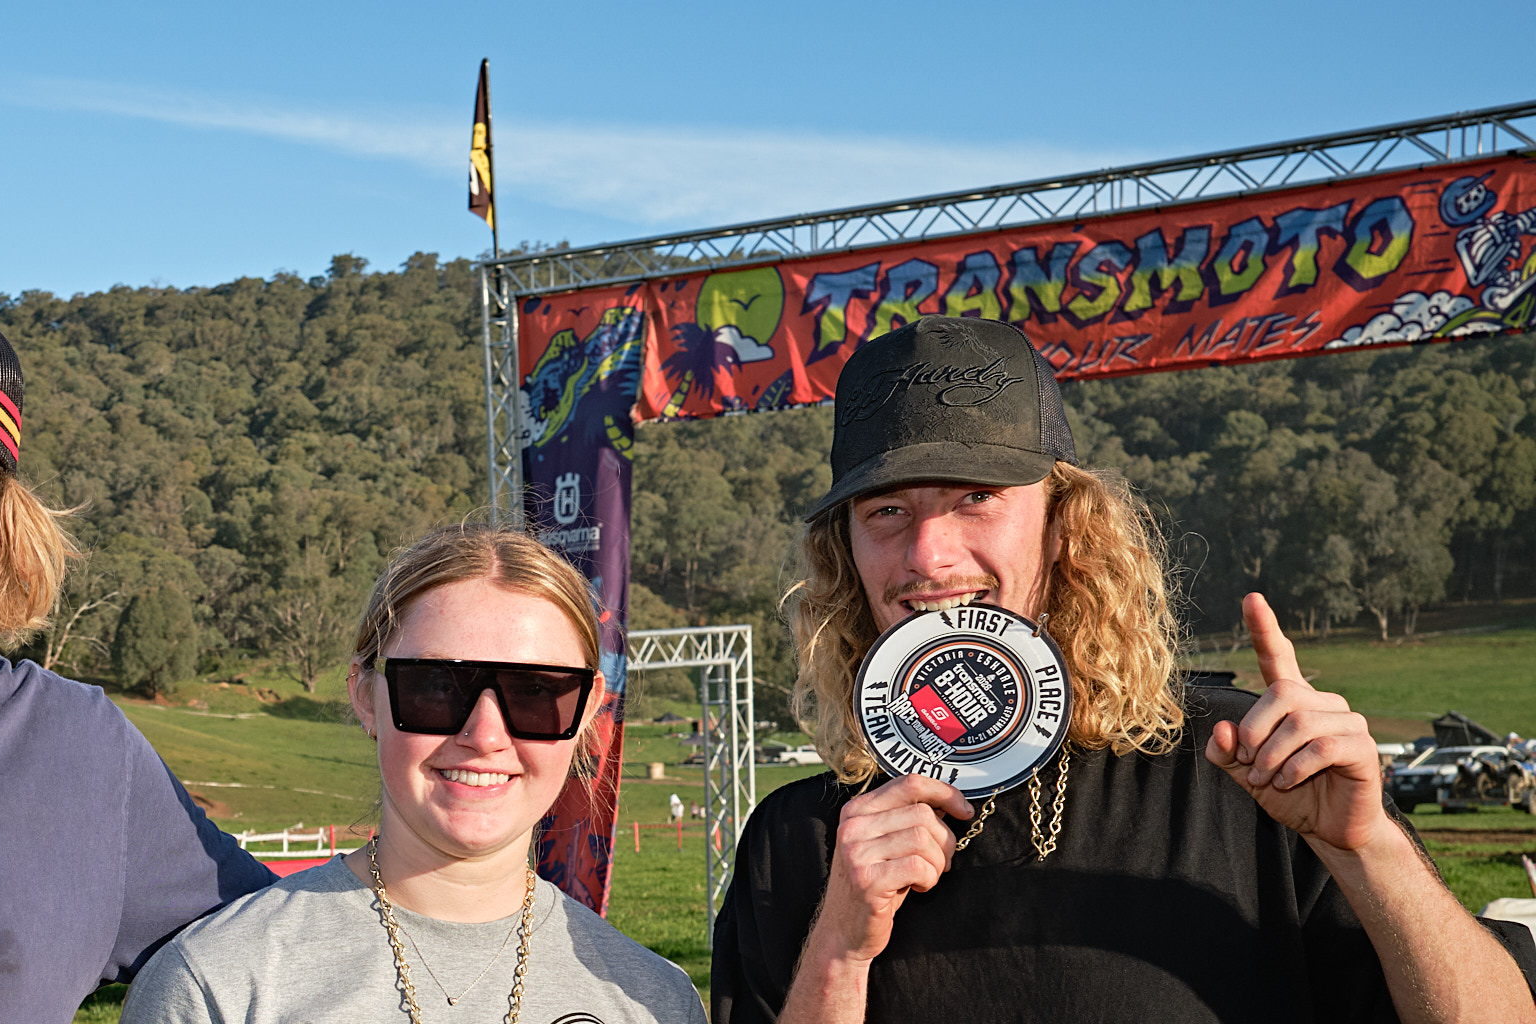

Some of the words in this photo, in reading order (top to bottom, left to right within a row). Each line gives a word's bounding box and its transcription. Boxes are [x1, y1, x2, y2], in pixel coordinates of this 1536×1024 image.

[801, 196, 1415, 361] TRANSMOTO
[1040, 334, 1153, 375] OUR
[1172, 310, 1326, 361] MATES
[916, 650, 963, 681] VICTORIA
[953, 663, 997, 714] transmoto
[958, 609, 1013, 636] FIRST
[1035, 665, 1062, 723] PLACE
[974, 674, 993, 691] 2026
[976, 653, 1015, 695] ESKDALE
[865, 695, 895, 744] TEAM
[921, 709, 942, 730] GASGAS
[934, 670, 988, 727] 8-HOUR
[986, 706, 1014, 739] SEPTEMBER
[886, 691, 919, 726] RACE
[918, 728, 956, 764] MATES!
